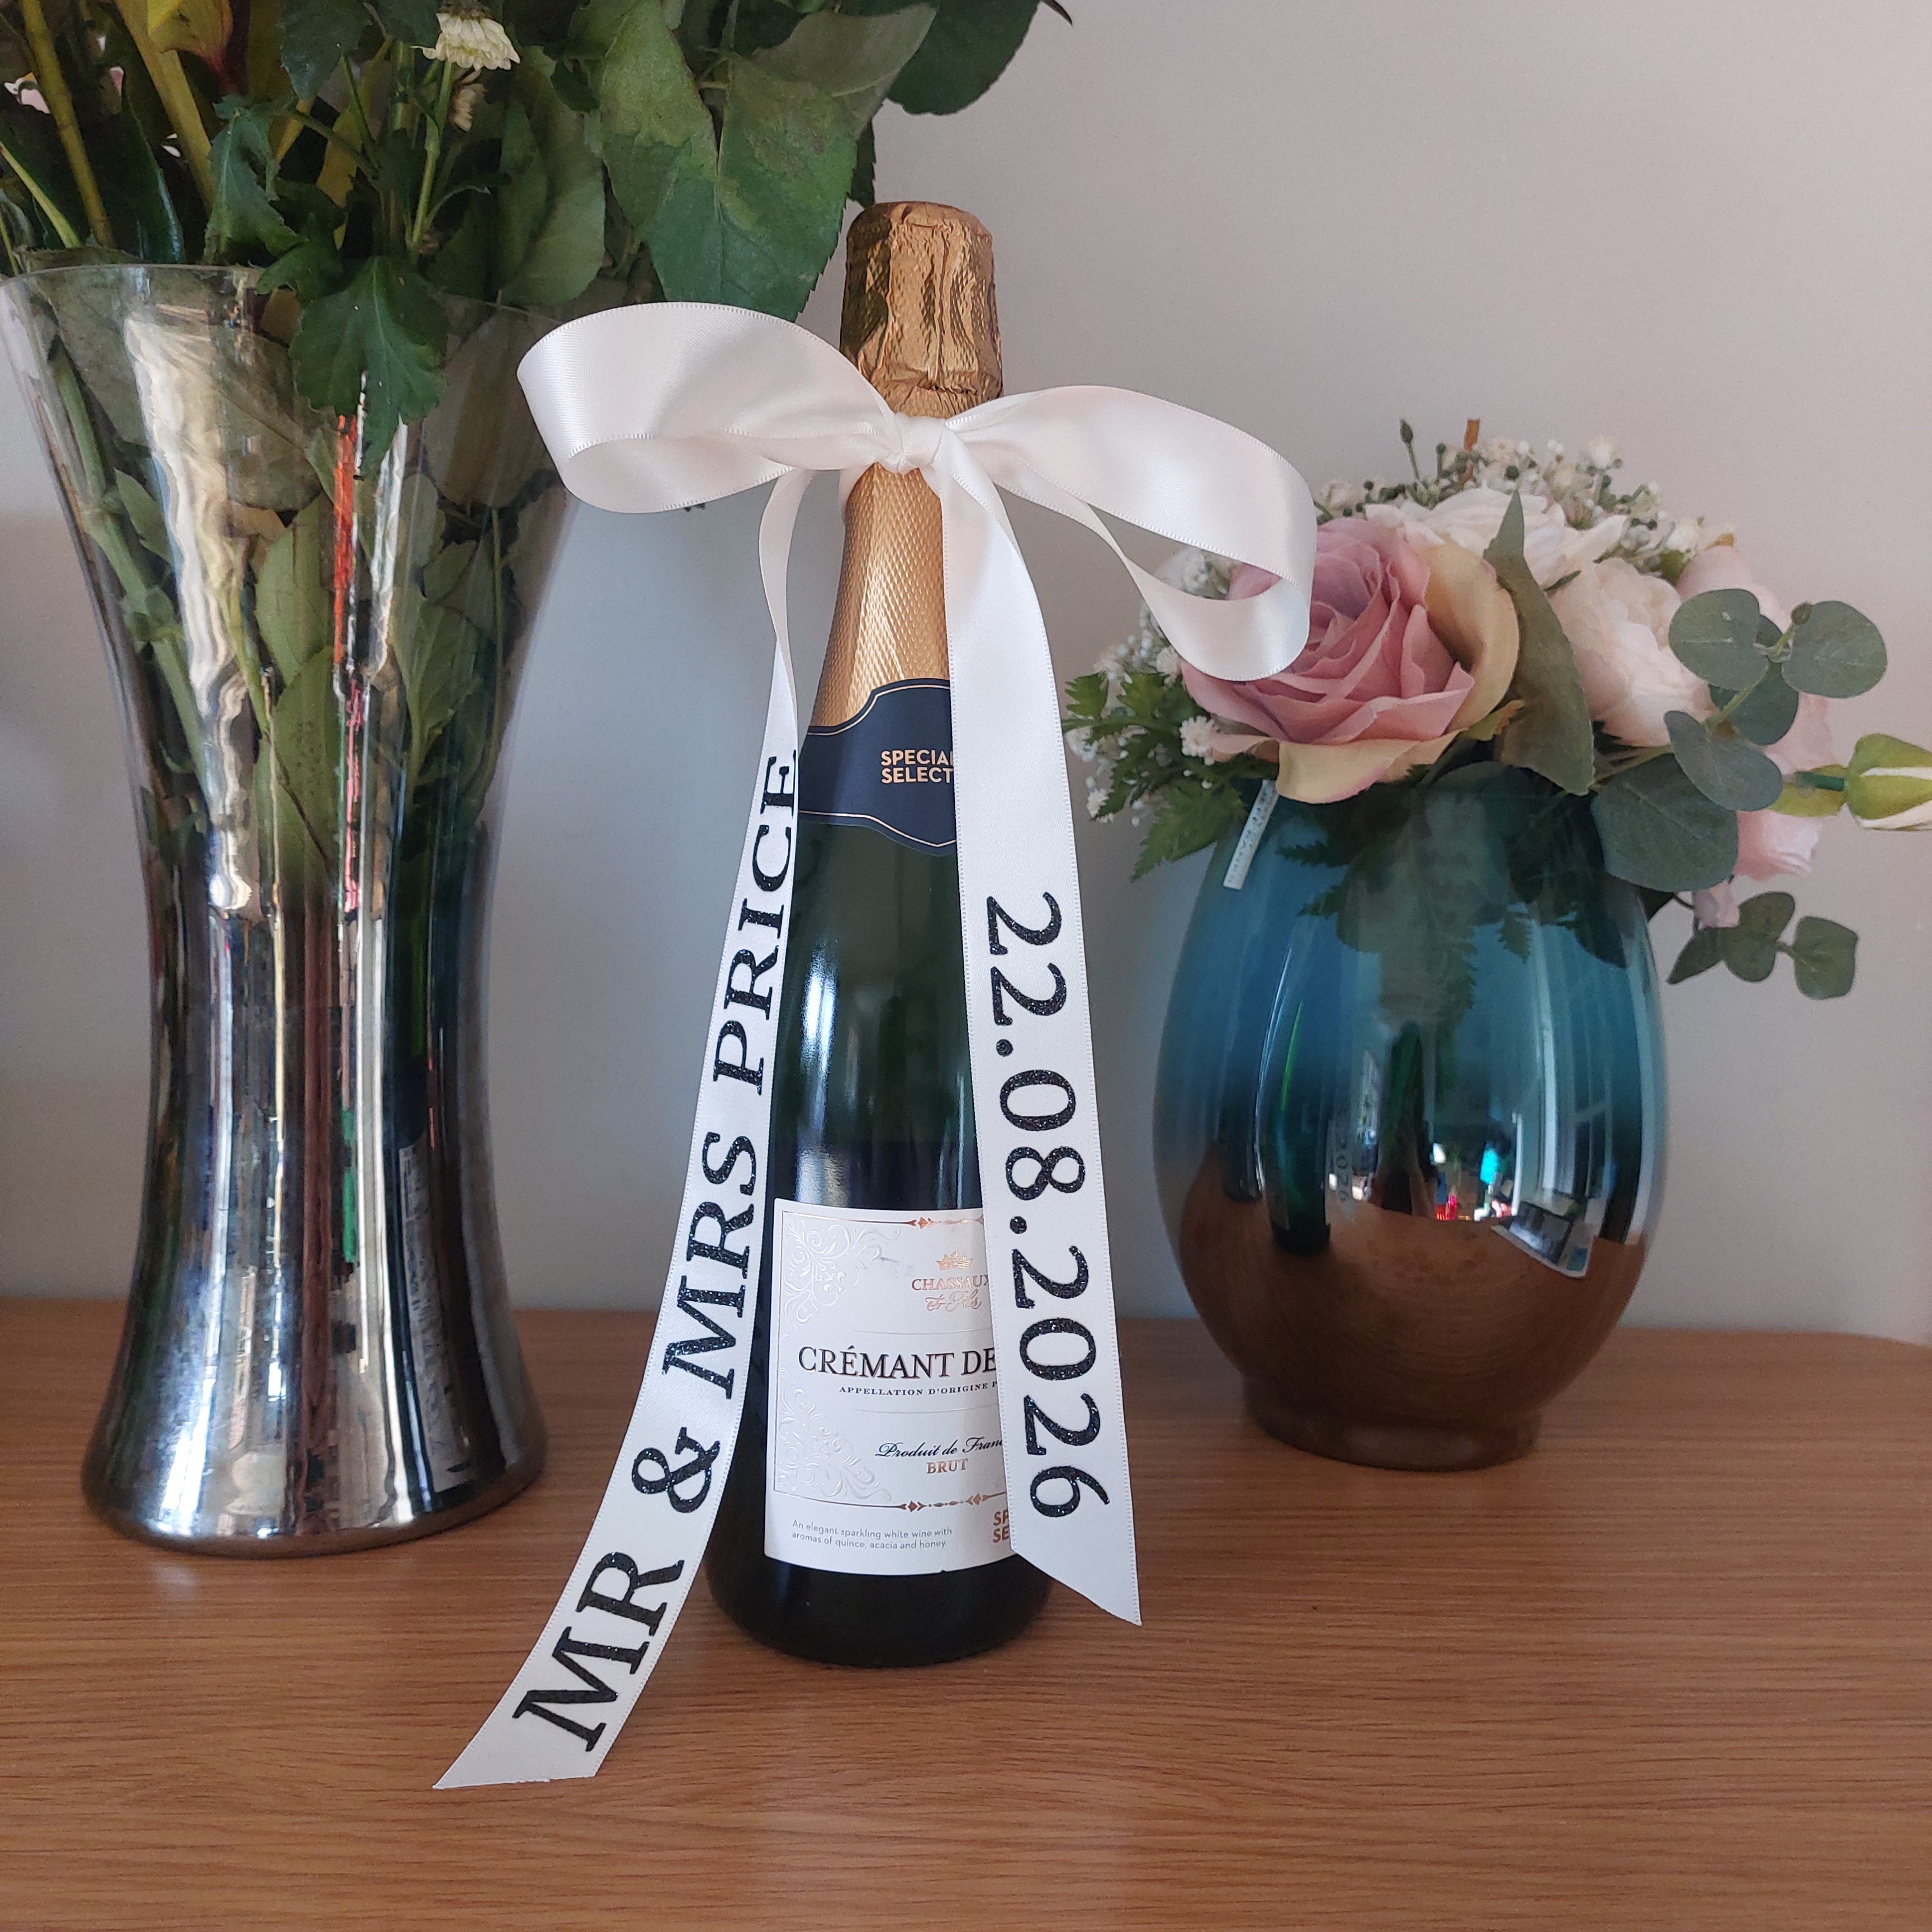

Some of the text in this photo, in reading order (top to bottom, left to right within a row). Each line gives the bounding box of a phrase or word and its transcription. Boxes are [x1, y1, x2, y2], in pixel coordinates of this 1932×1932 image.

[986, 892, 1110, 1518] 22.08.2026
[512, 750, 796, 1752] MR & MRS PRICE
[798, 1344, 997, 1379] CRÉMANT DE
[839, 1386, 924, 1396] APPELLATION
[928, 1382, 988, 1395] D'ORIGINE
[875, 1442, 941, 1458] Produit
[941, 1439, 958, 1455] de
[926, 1458, 968, 1474] BRUT
[792, 1519, 952, 1540] An elegant sparkling white wine with
[792, 1532, 821, 1543] aromas
[823, 1536, 833, 1545] of
[870, 1541, 897, 1550] acacia
[899, 1540, 917, 1550] and
